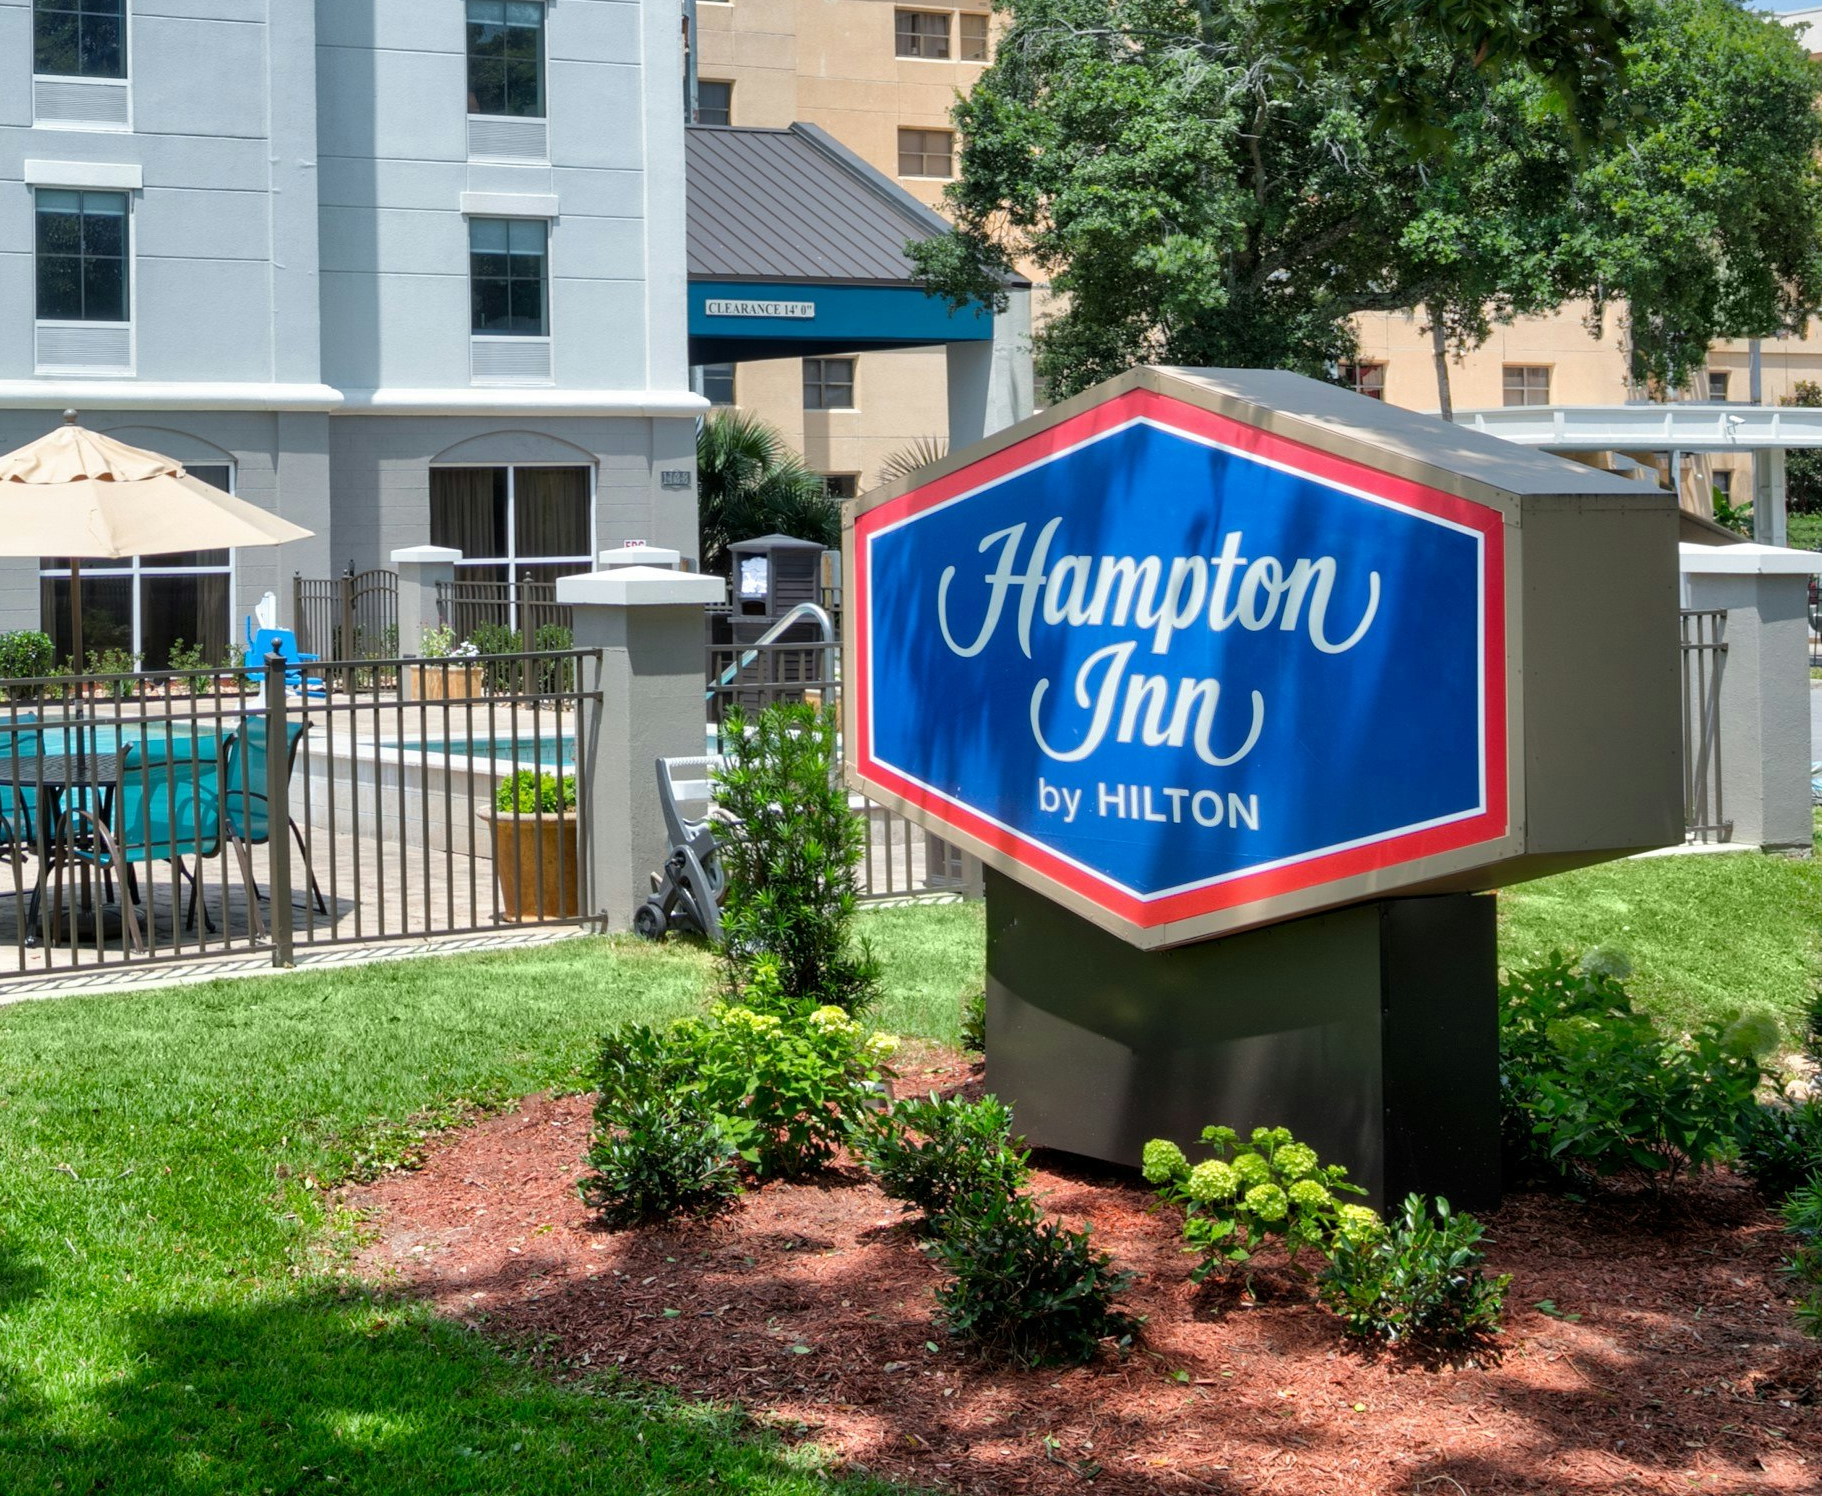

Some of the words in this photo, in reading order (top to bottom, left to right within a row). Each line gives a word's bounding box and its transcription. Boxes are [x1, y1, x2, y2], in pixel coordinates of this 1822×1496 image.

[708, 302, 781, 315] CLEARANCE
[784, 304, 798, 316] 14'
[937, 516, 1380, 660] Hampton
[1030, 640, 1264, 767] Inn
[1038, 777, 1082, 823] by
[1098, 781, 1259, 831] HILTON
